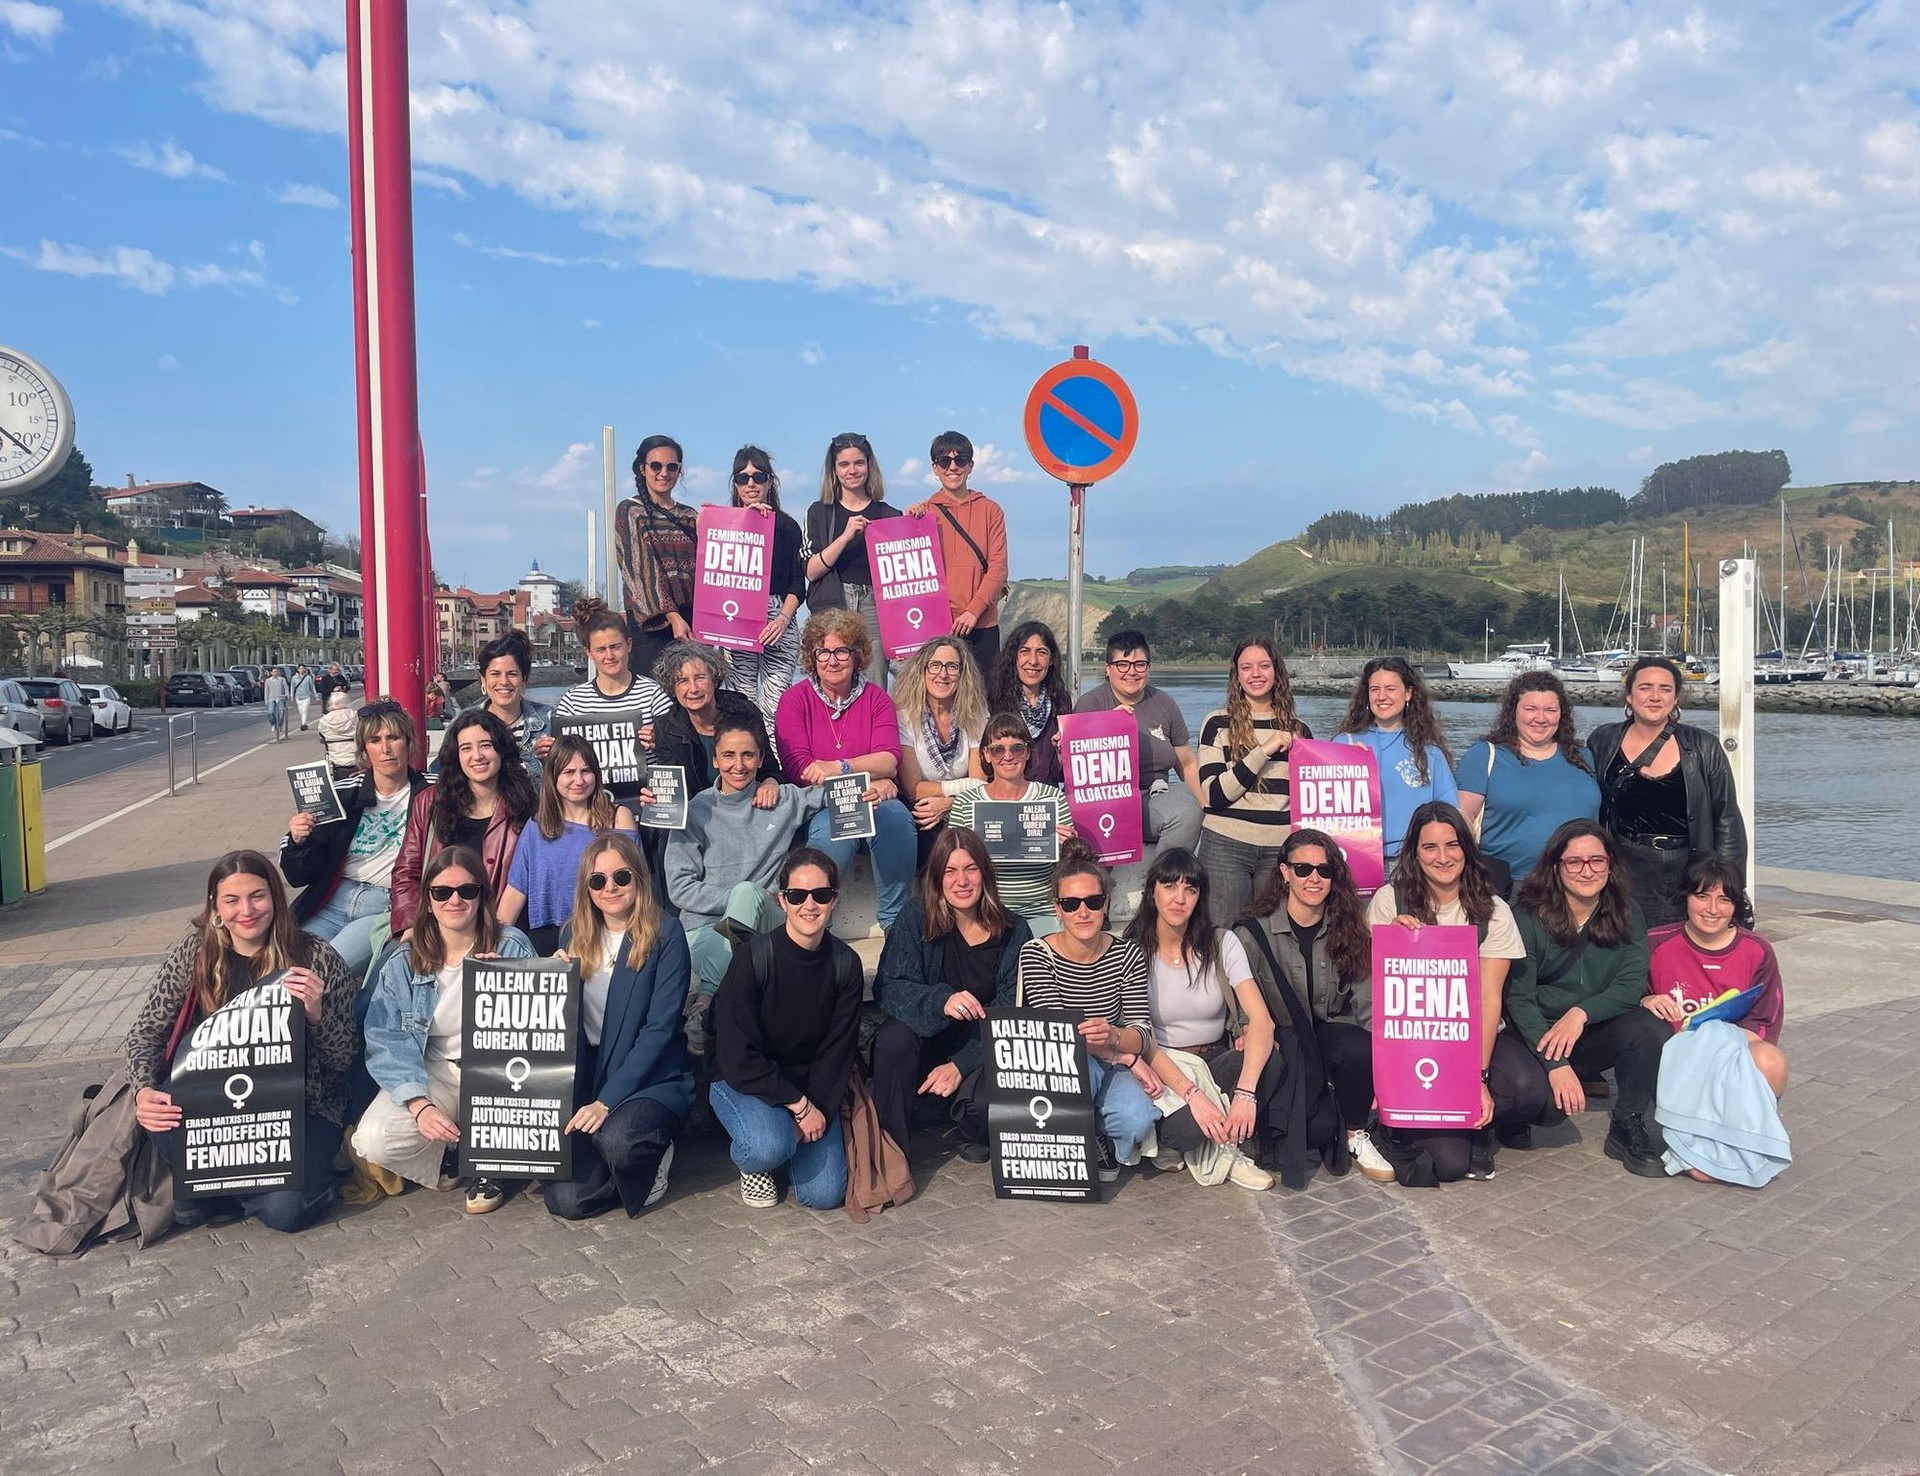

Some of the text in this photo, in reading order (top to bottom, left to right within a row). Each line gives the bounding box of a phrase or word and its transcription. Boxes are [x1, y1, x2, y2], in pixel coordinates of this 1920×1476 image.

[706, 527, 765, 547] FEMINISMOA
[875, 535, 932, 556] FEMINISMOA
[704, 540, 764, 577] DENA
[876, 548, 938, 585] DENA
[703, 570, 762, 592] ALDATZEKO
[882, 578, 940, 601] ALDATZEKO
[612, 722, 635, 740] ETA
[1069, 734, 1130, 754] FEMINISMOA
[612, 767, 639, 784] DIRA
[1070, 749, 1132, 787] DENA
[1299, 765, 1369, 780] FEMINISMOA
[1073, 782, 1132, 804] ALDATZEKO
[1300, 780, 1372, 814] DENA
[1383, 957, 1469, 976] FEMINISMOA
[475, 971, 568, 993] KALEAK ETA
[260, 984, 292, 1006] ETA
[1383, 976, 1470, 1019] DENA
[474, 993, 567, 1030] GAUAK
[190, 1006, 293, 1049] GAUAK
[991, 1019, 1076, 1043] KALEAK ETA
[1383, 1019, 1470, 1042] ALDATZEKO
[472, 1031, 565, 1052] GUREAK DIRA
[185, 1044, 293, 1071] GUREAK DIRA
[994, 1038, 1079, 1075] GAUAK
[996, 1071, 1081, 1094] GUREAK DIRA
[471, 1096, 493, 1106] ERASO
[531, 1098, 561, 1109] AURREAN
[185, 1118, 211, 1129] ERASO
[257, 1110, 292, 1122] AURREAN
[471, 1107, 560, 1127] AUTODEFENTSA
[186, 1121, 291, 1146] AUTODEFENTSA
[470, 1125, 561, 1152] FEMINISTA
[999, 1132, 1020, 1141] ERASO
[1056, 1134, 1086, 1144] AURREAN
[185, 1139, 292, 1170] FEMINISTA
[1001, 1142, 1086, 1160] AUTODEFENTSA
[1001, 1159, 1089, 1181] FEMINISTA
